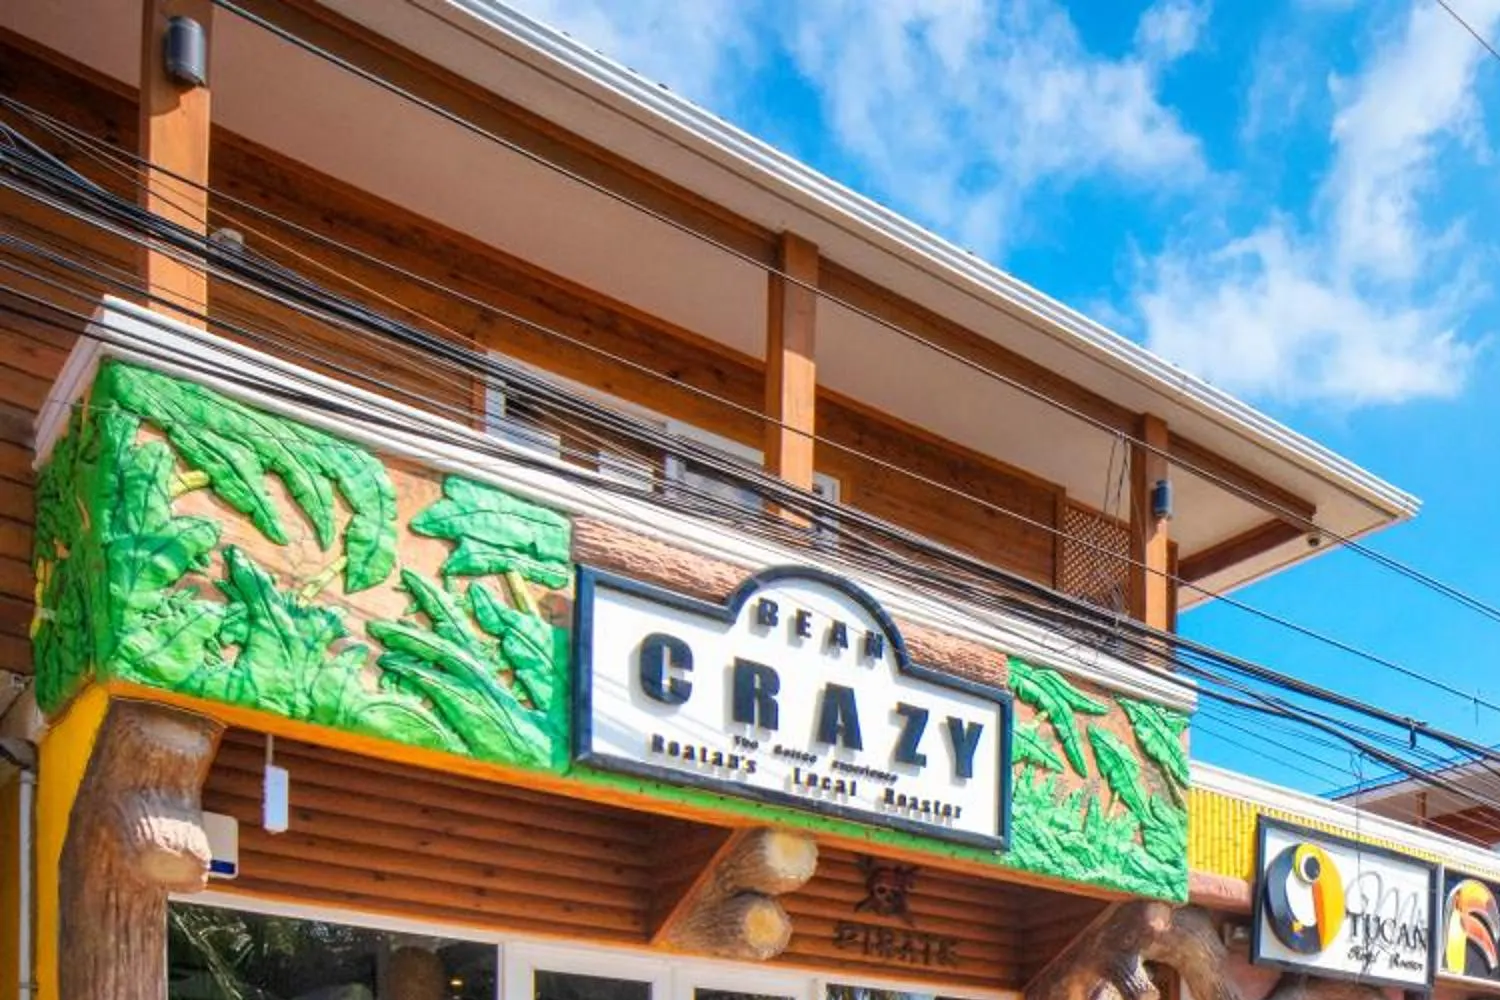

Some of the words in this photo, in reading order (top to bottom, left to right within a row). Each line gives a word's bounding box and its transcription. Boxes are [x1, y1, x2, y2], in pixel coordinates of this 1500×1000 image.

[755, 597, 885, 660] BEAN
[639, 631, 985, 779] CRAZY
[792, 766, 857, 797] Local
[883, 786, 963, 819] Roaster
